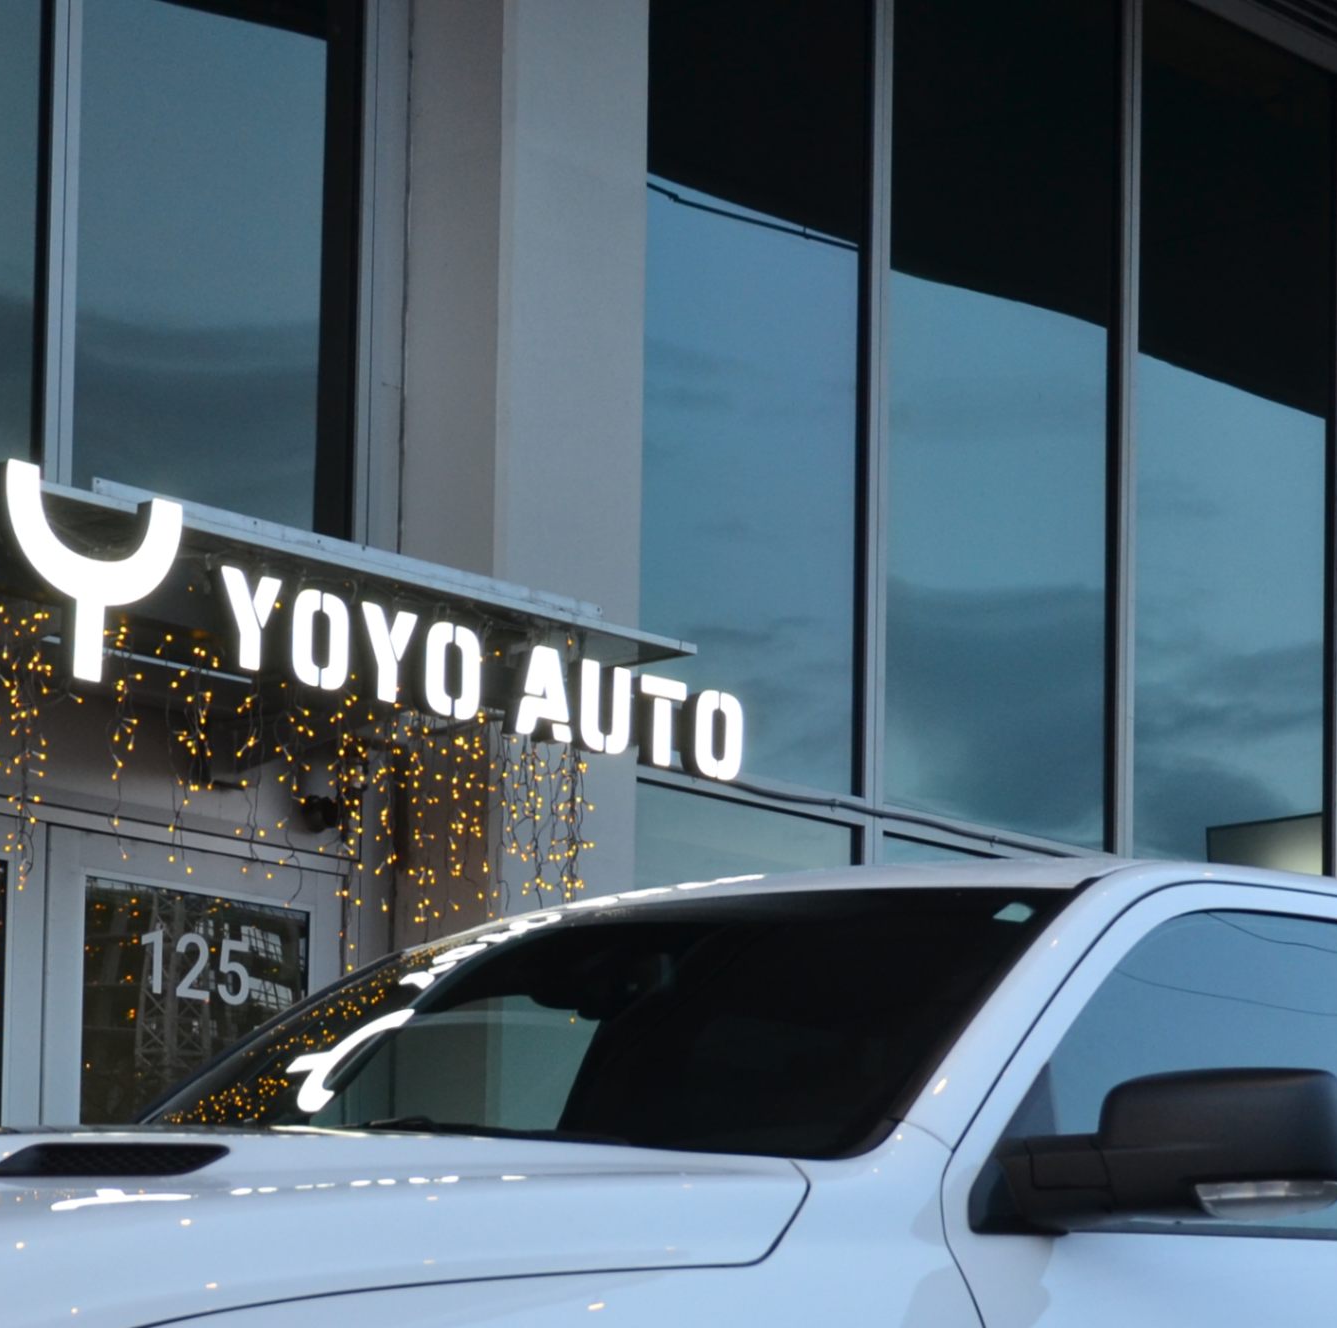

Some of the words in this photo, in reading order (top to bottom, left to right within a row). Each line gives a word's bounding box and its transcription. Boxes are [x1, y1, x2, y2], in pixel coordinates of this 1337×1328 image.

[221, 566, 481, 720] YOYO
[515, 645, 744, 781] AUTO
[141, 929, 250, 1006] 125
